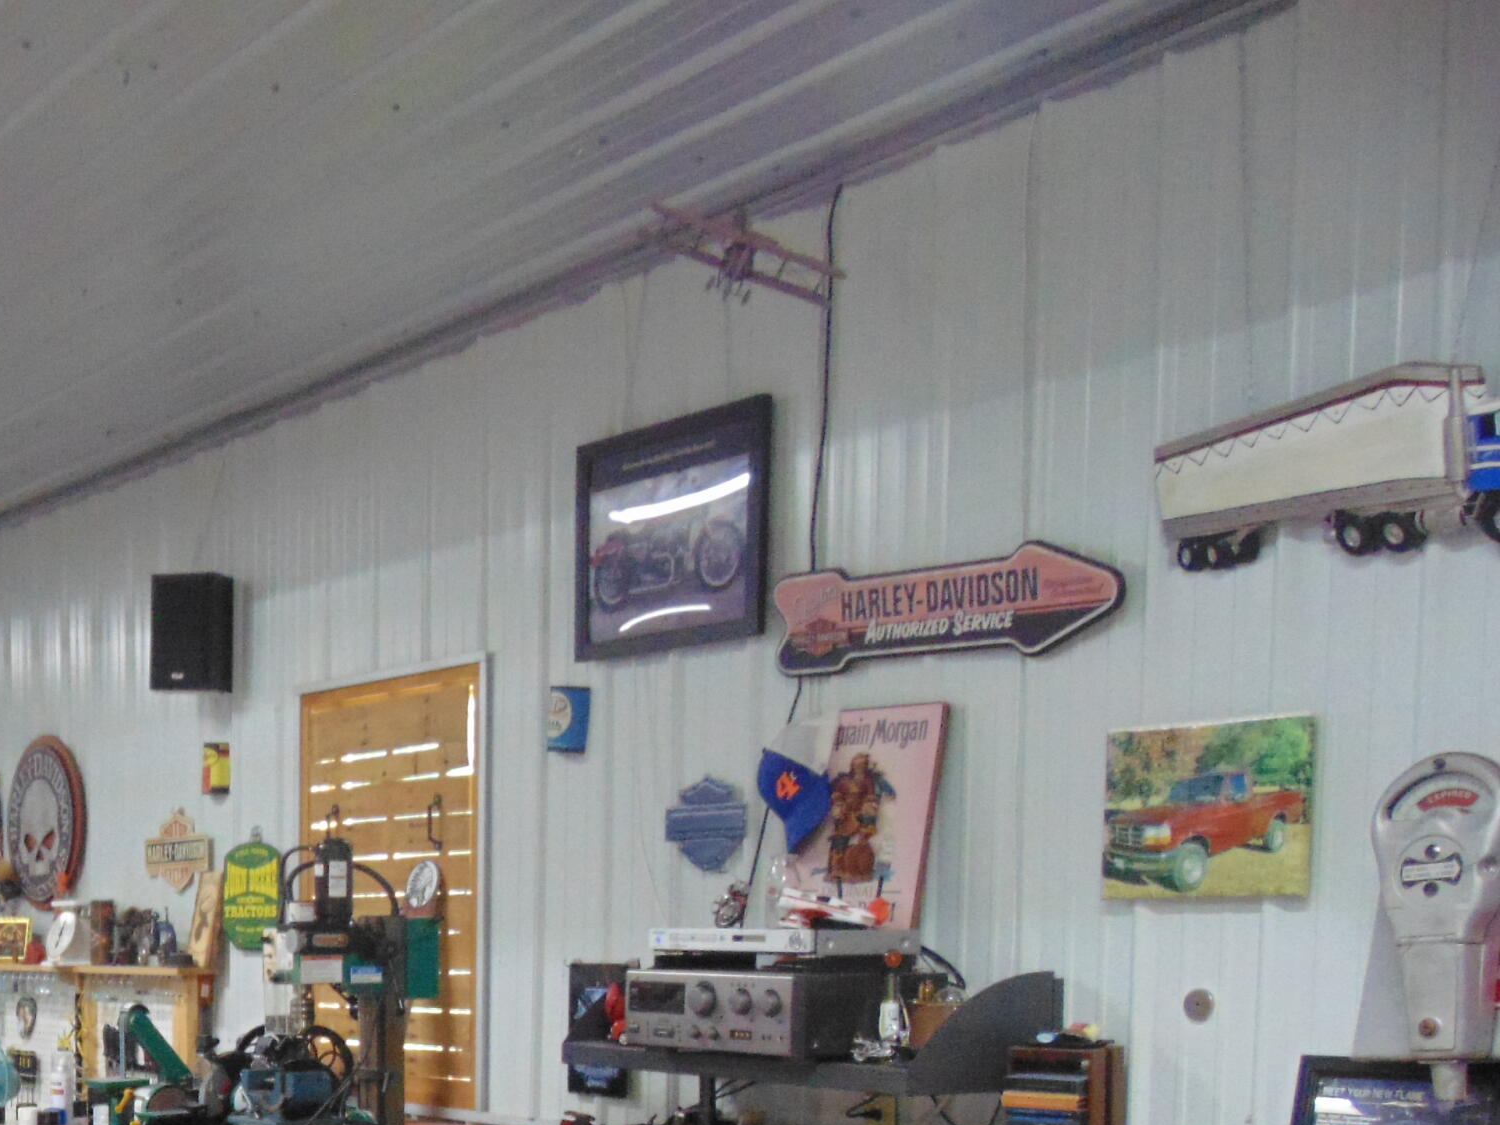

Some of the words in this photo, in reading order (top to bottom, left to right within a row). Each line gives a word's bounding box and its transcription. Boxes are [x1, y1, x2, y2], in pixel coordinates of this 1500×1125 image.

[840, 566, 1040, 622] HARLEY-DAVIDSON
[864, 614, 949, 645] AUTHORIZED
[951, 609, 1014, 637] SERVICE
[869, 718, 929, 750] Morgan
[224, 904, 278, 919] TRACTORS
